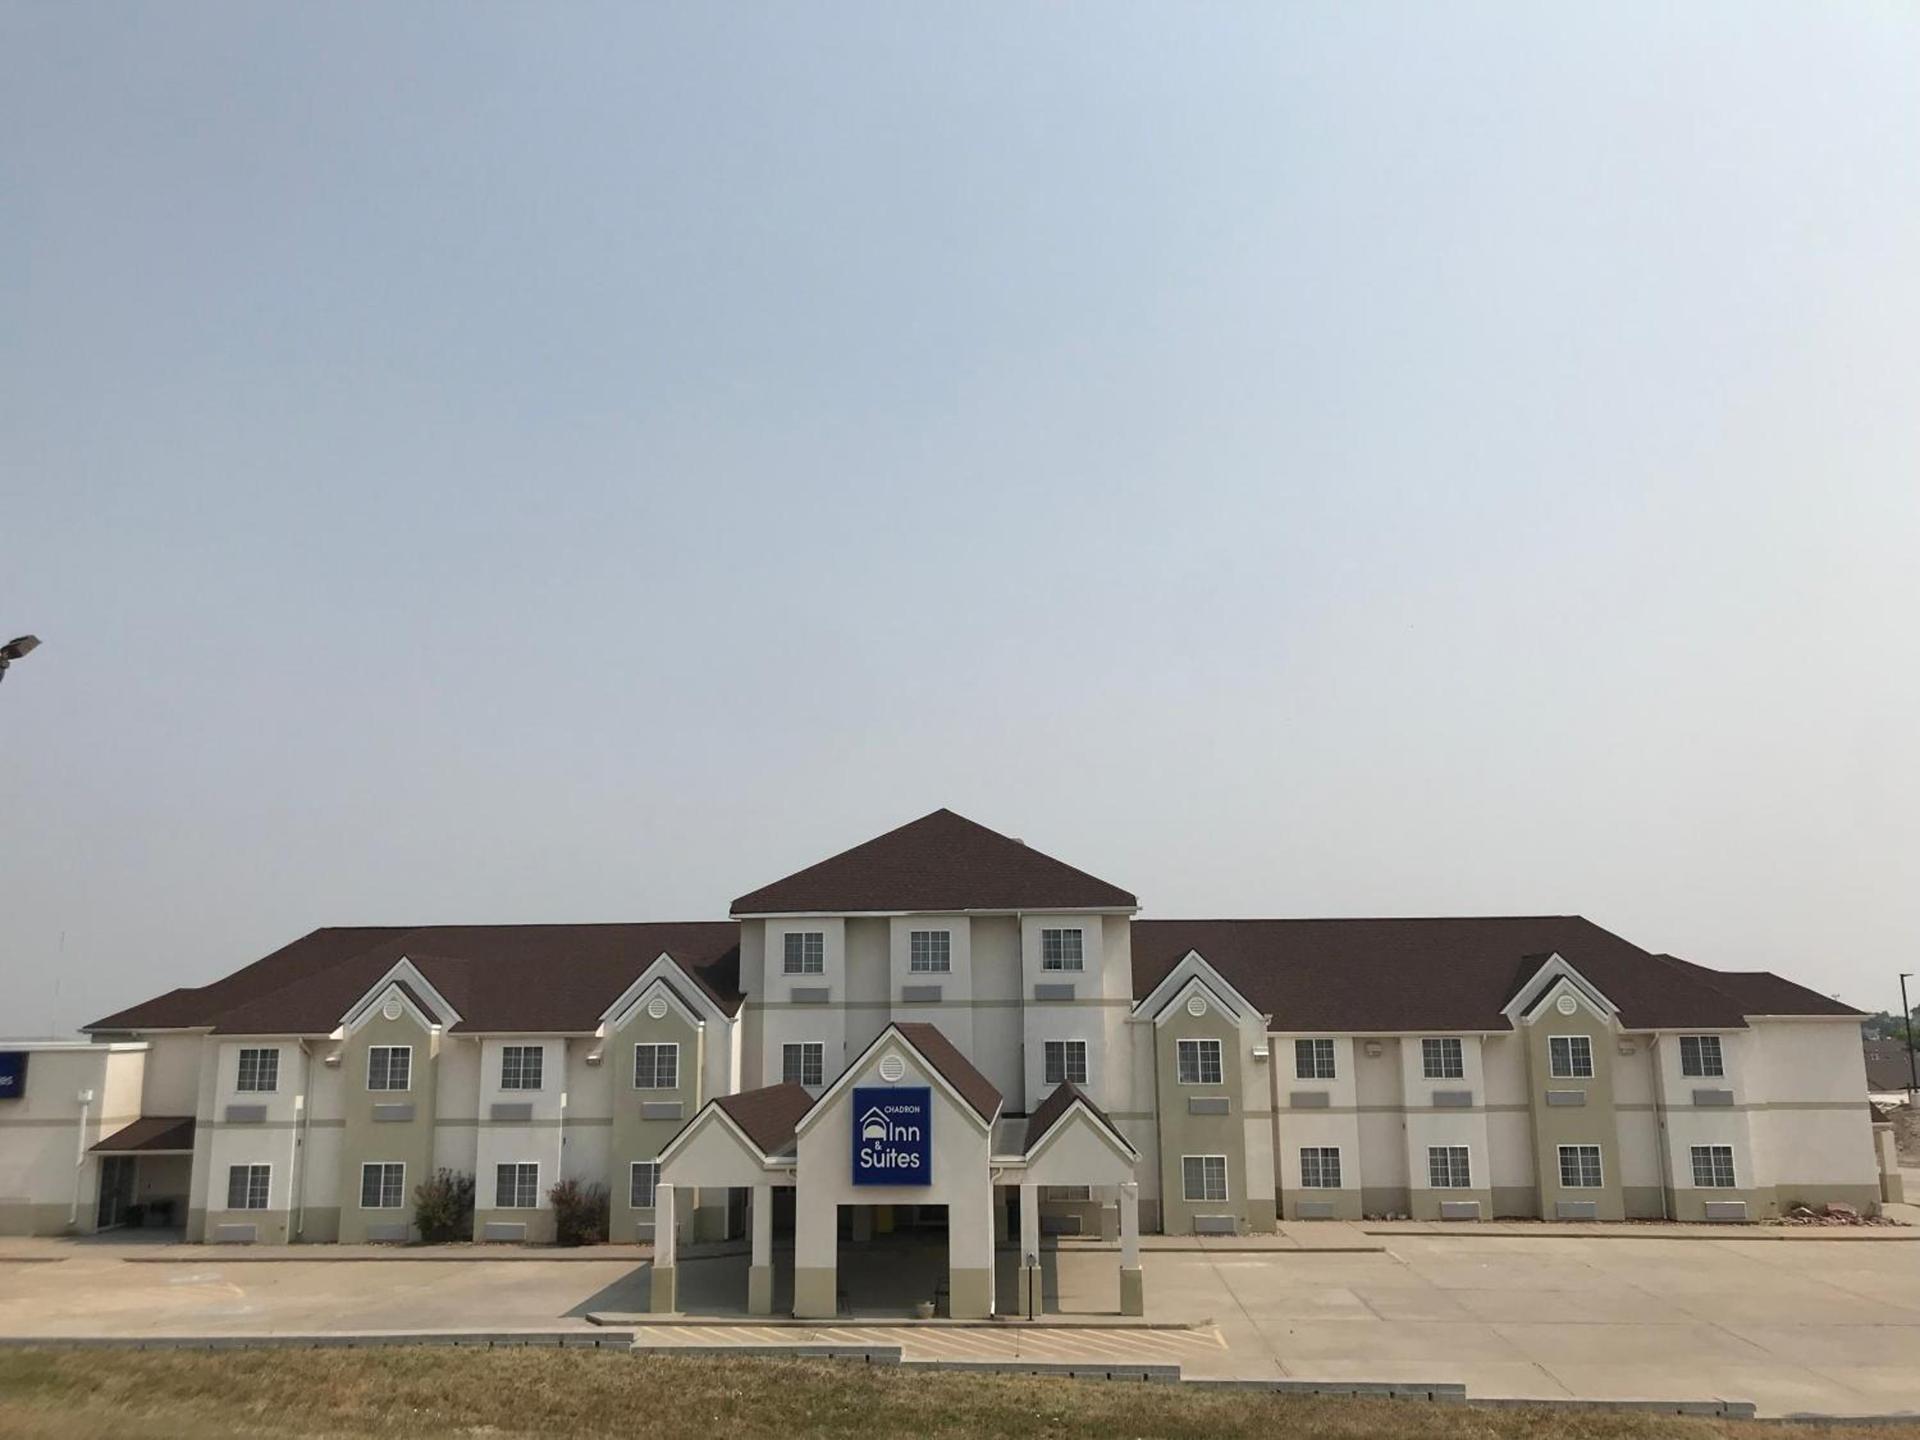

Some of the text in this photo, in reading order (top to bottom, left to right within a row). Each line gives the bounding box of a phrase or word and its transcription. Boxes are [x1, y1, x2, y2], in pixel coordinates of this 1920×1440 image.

[884, 1105, 920, 1113] CHADRON
[889, 1122, 920, 1141] Inn
[874, 1140, 882, 1150] &
[860, 1148, 920, 1168] Suites
